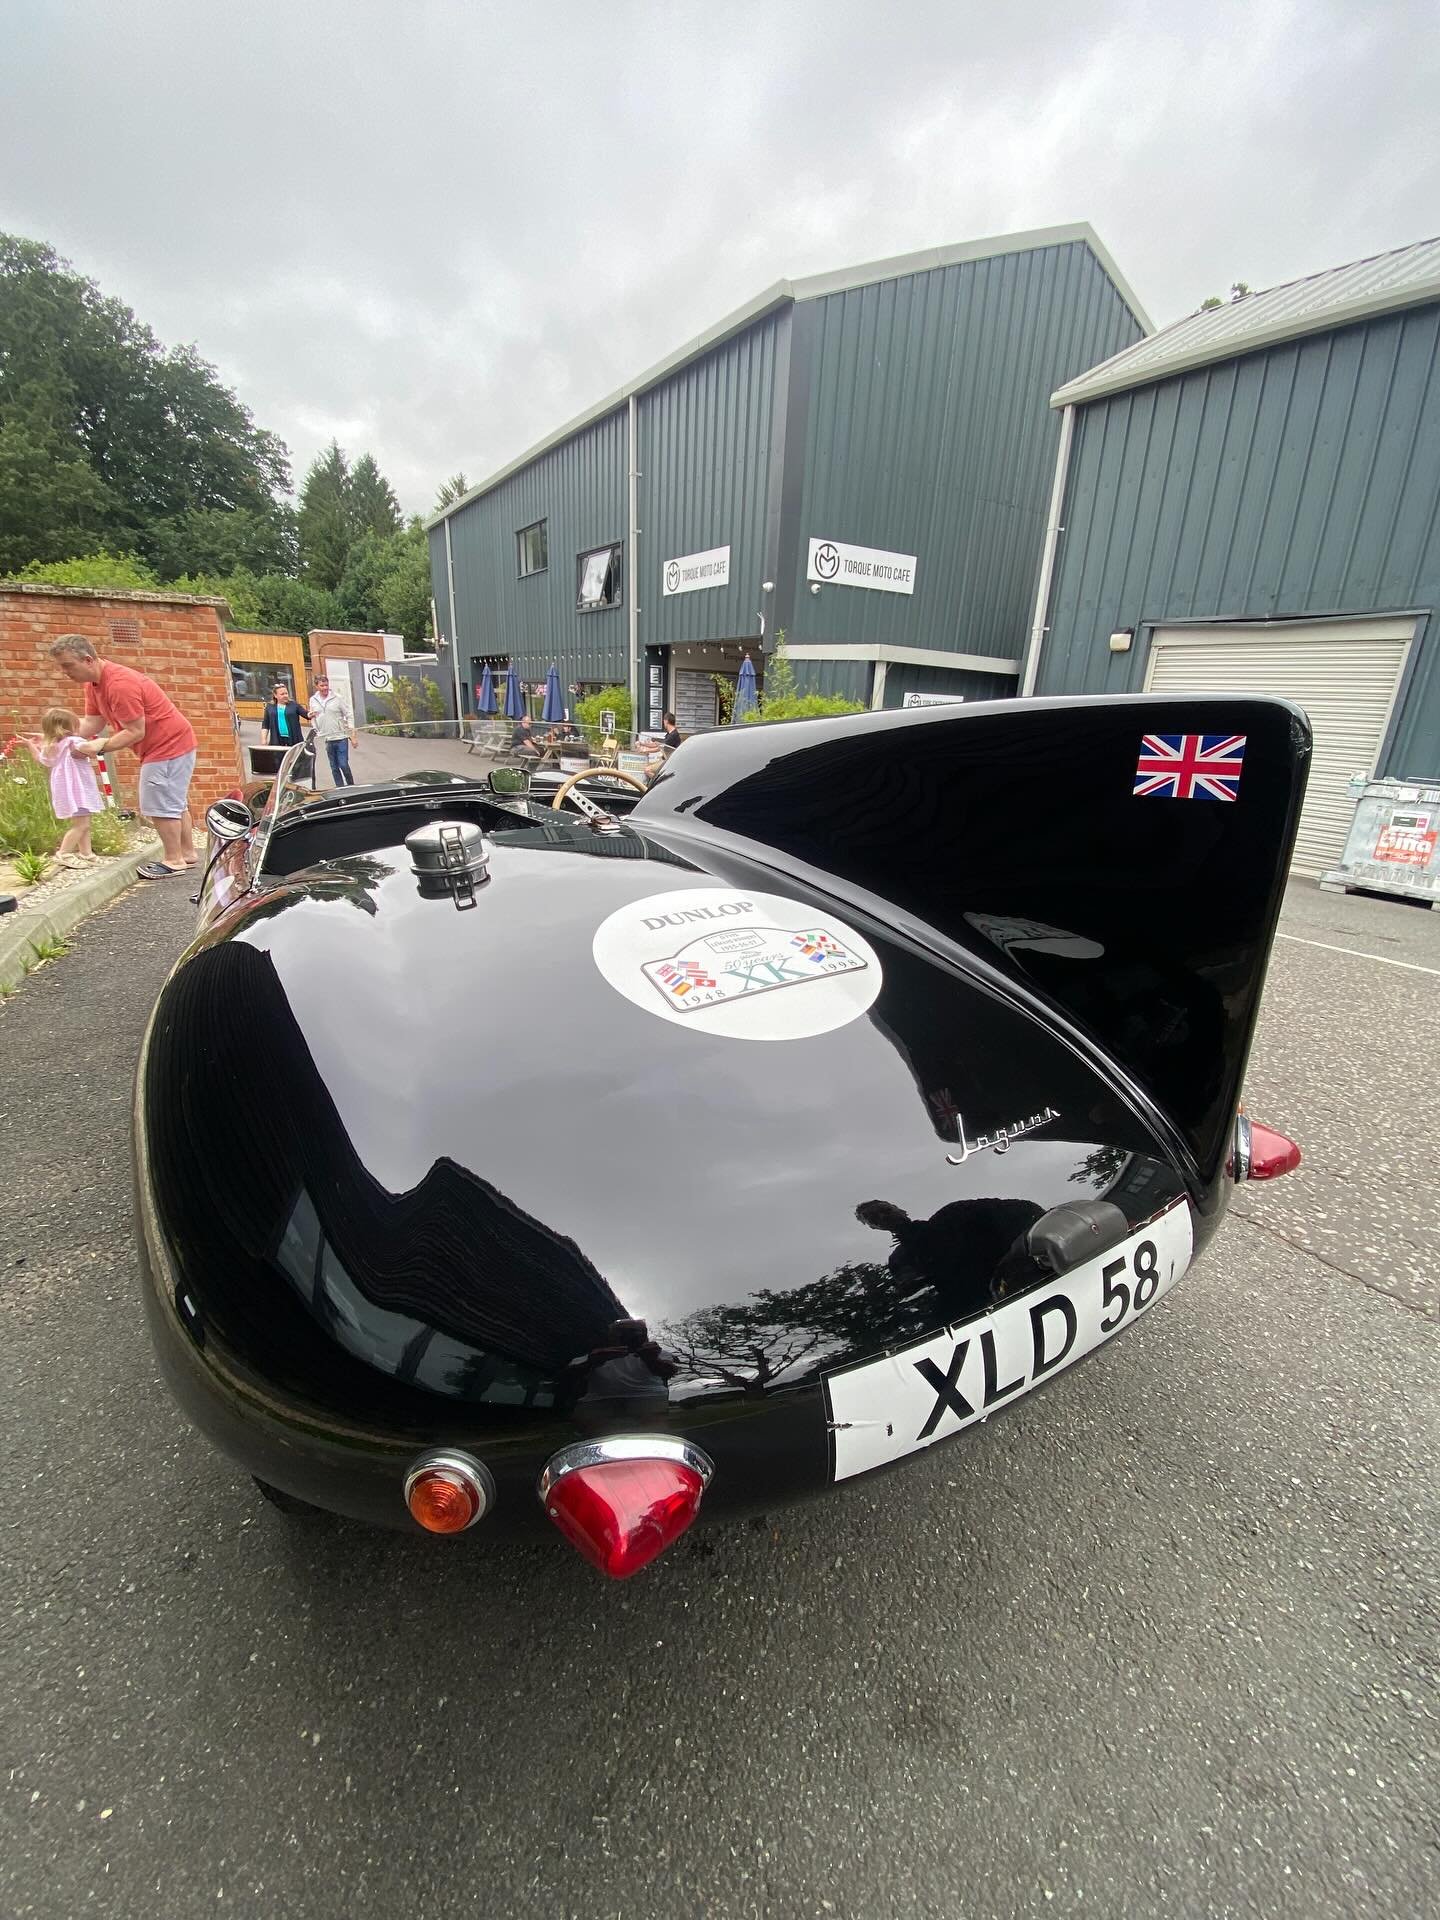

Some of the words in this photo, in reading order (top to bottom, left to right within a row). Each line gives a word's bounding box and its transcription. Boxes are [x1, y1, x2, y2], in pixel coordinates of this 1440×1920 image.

[700, 564, 712, 577] MOTO
[714, 561, 726, 575] CAFE
[844, 560, 872, 576] TORQUE
[872, 565, 892, 579] MOTO
[893, 568, 911, 582] CAFE
[640, 901, 754, 930] DUNLOP
[724, 959, 741, 970] 50
[743, 952, 784, 970] years
[822, 960, 858, 972] 1998
[720, 957, 814, 993] XK
[682, 989, 727, 1007] 1948
[946, 1107, 1061, 1164] Jaguar
[913, 1294, 1078, 1441] XLD
[1100, 1240, 1160, 1333] 58
